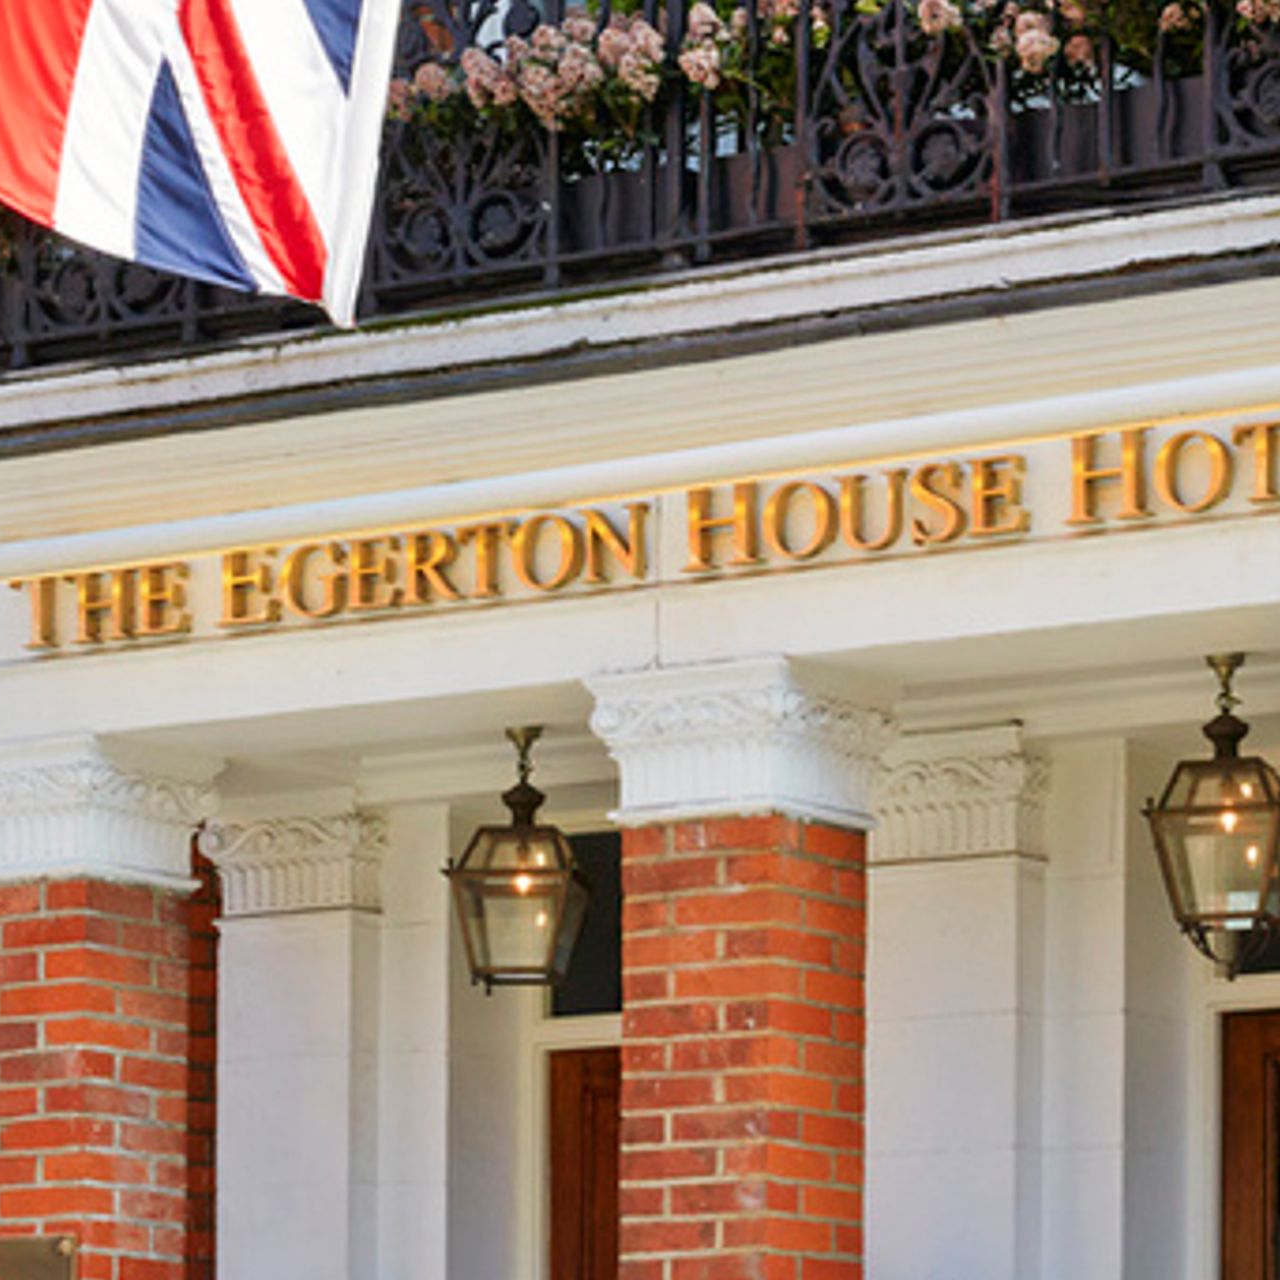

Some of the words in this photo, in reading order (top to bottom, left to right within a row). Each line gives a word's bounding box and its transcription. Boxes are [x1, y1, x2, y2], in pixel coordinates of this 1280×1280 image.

[10, 561, 192, 650] THE
[214, 502, 651, 630] EGERTON
[680, 452, 1033, 573] HOUSE
